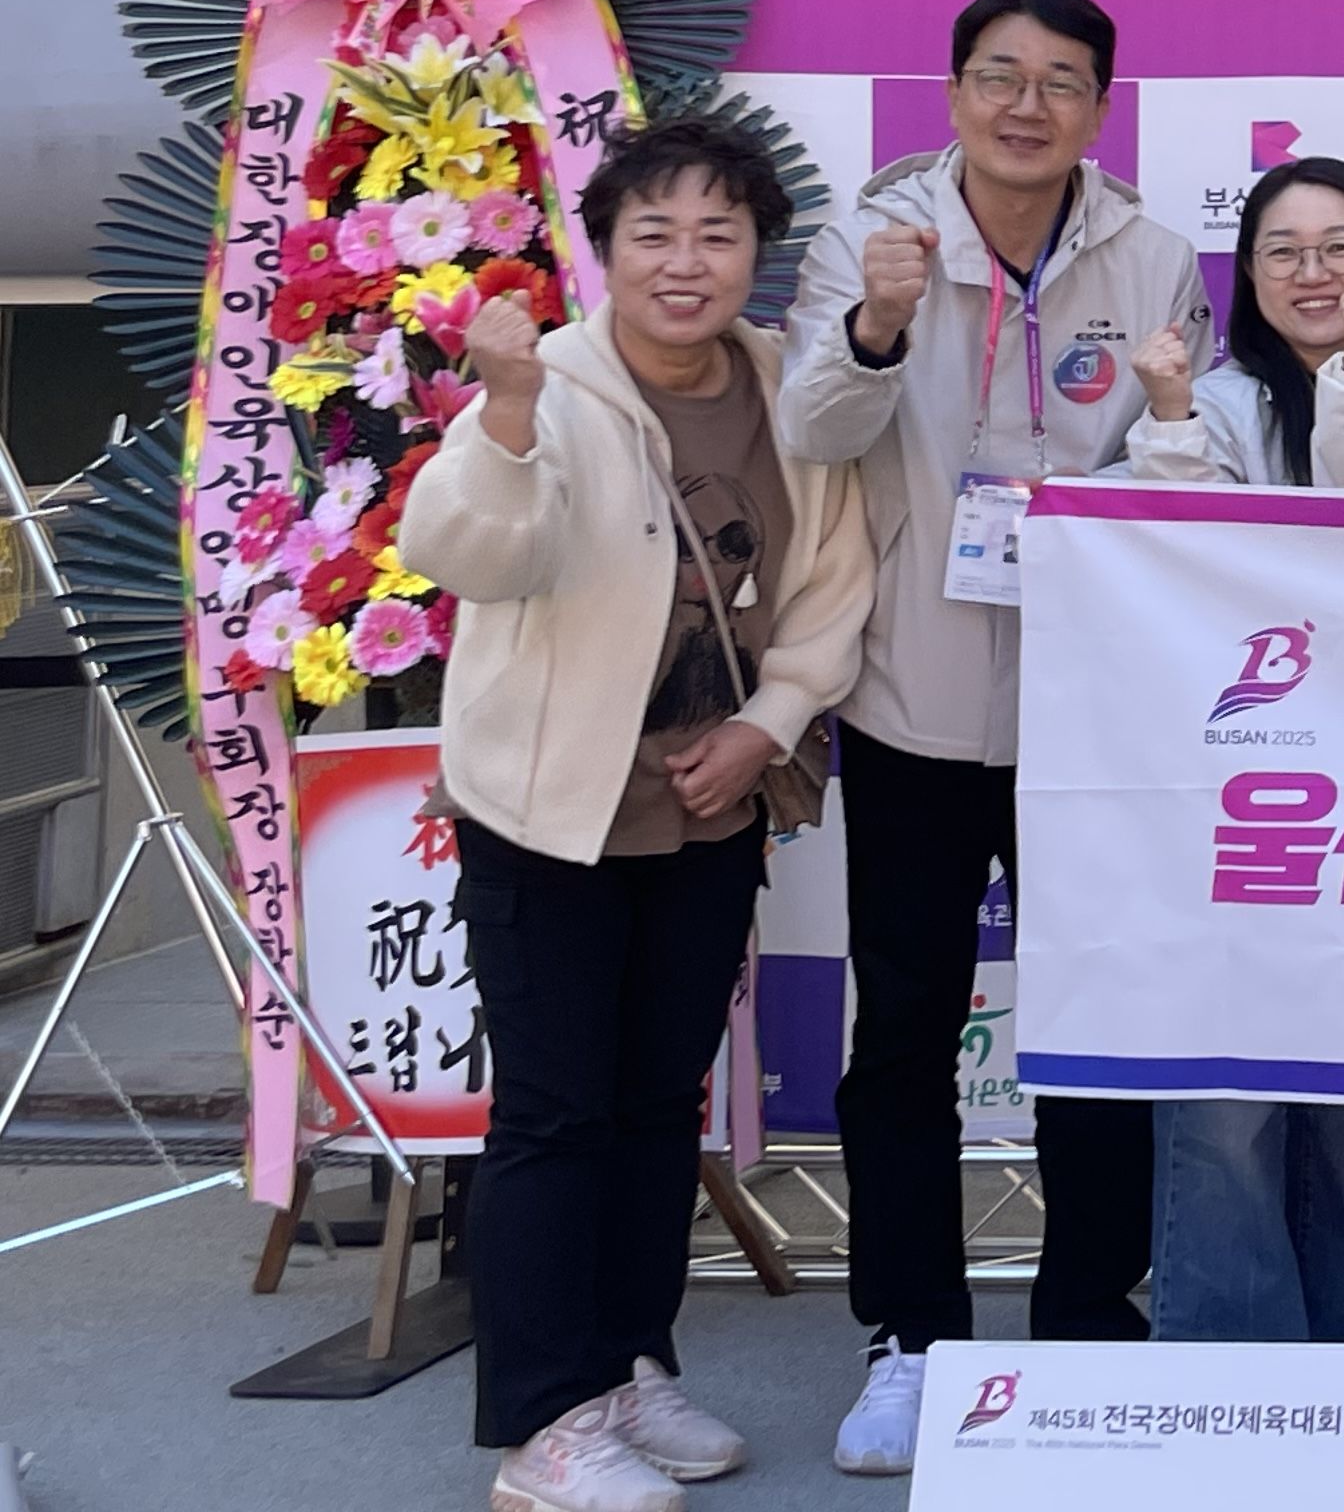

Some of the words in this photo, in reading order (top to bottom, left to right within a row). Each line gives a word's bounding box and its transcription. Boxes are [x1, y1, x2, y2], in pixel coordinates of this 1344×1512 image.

[1204, 729, 1268, 745] BUSAN
[1270, 729, 1317, 746] 2025
[1027, 1407, 1097, 1432] 제45회
[1101, 1404, 1343, 1437] 전국장애인체육대회
